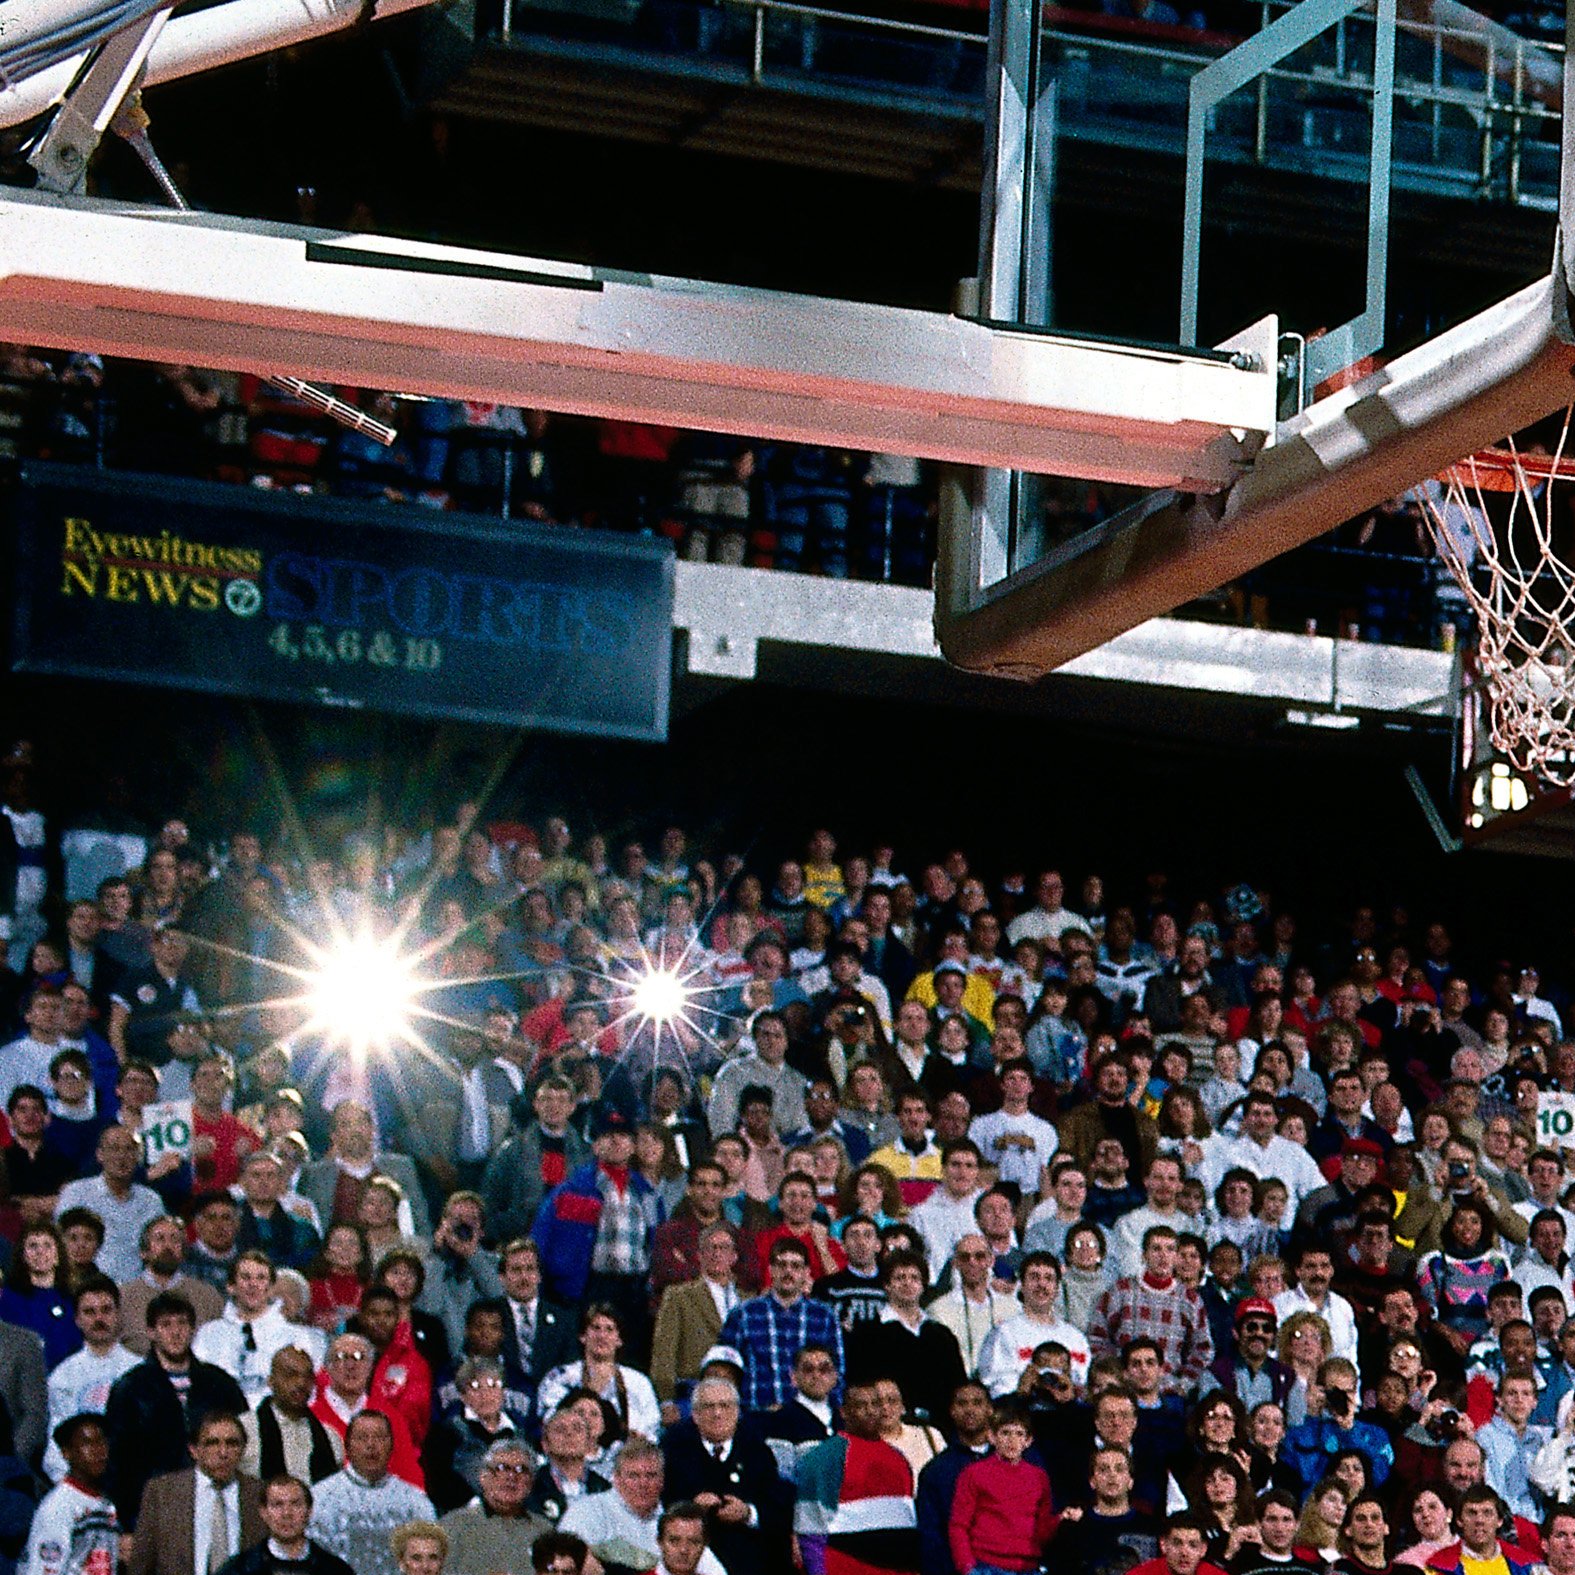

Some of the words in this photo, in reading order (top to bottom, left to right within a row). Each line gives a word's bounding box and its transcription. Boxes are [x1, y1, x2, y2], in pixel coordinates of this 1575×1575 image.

[64, 517, 262, 571] Eyewitness
[61, 562, 220, 611] NEWS
[265, 554, 634, 654] SPORTS
[144, 1119, 191, 1152] 10
[1537, 1109, 1575, 1137] 10
